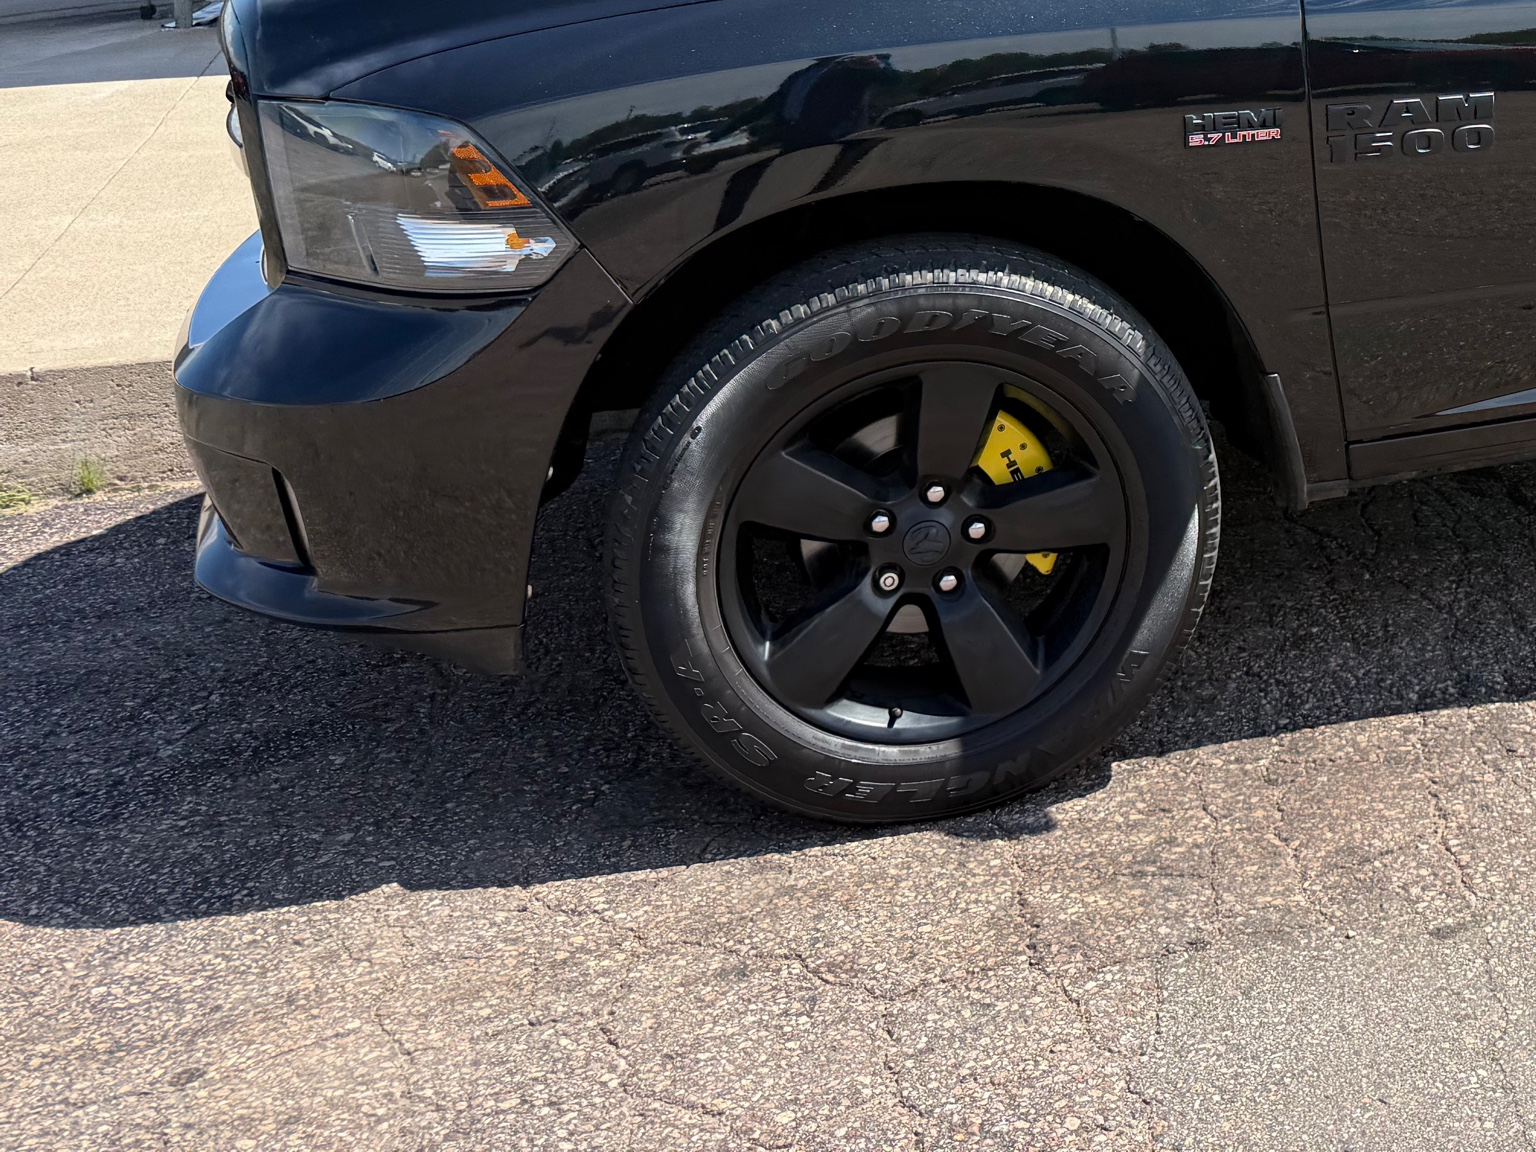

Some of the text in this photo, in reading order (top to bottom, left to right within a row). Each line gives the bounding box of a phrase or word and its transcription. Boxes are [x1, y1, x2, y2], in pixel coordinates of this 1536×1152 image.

[1184, 108, 1283, 134] HEMI
[1326, 91, 1495, 132] RAM
[1189, 128, 1281, 146] 5.7 LITER
[1326, 123, 1495, 162] 1500
[765, 309, 1138, 405] GOODYEAR
